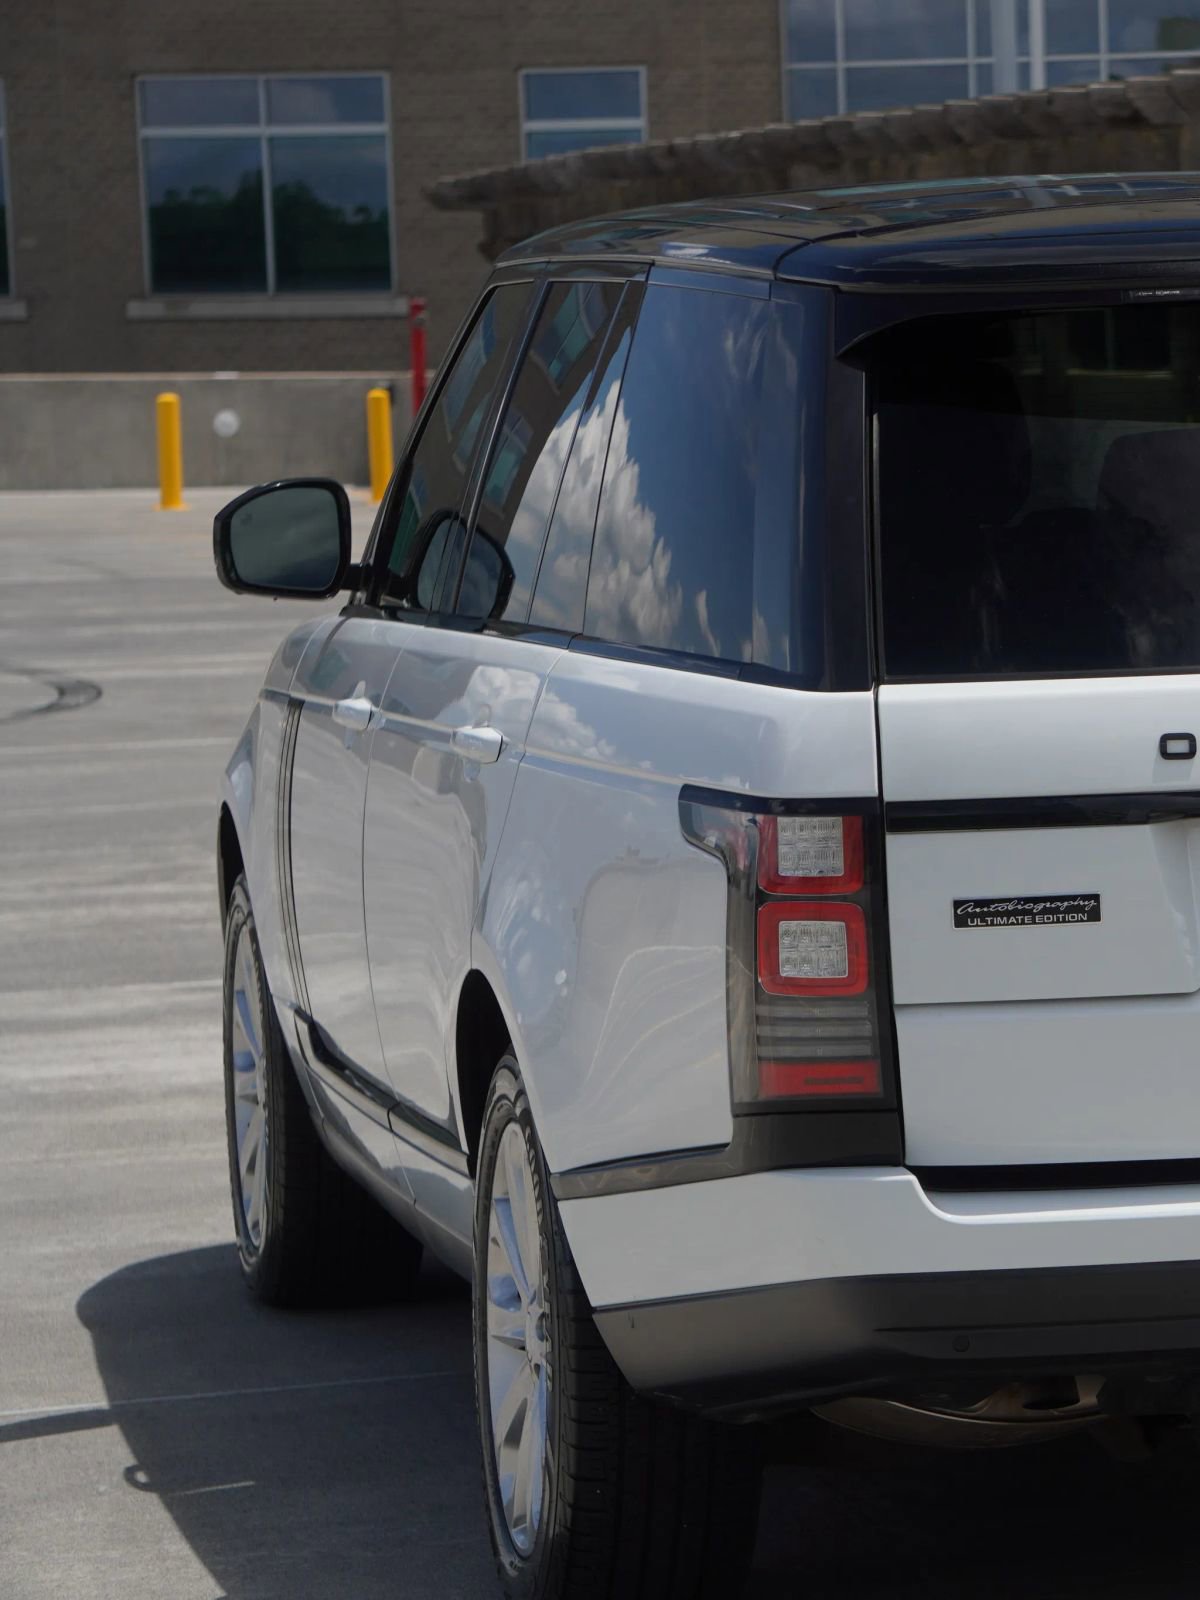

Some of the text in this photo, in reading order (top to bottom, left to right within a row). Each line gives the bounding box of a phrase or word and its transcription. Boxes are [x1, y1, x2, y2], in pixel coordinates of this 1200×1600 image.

[956, 897, 1098, 915] Autobiography
[967, 913, 1088, 926] ULTIMATE EDITION
